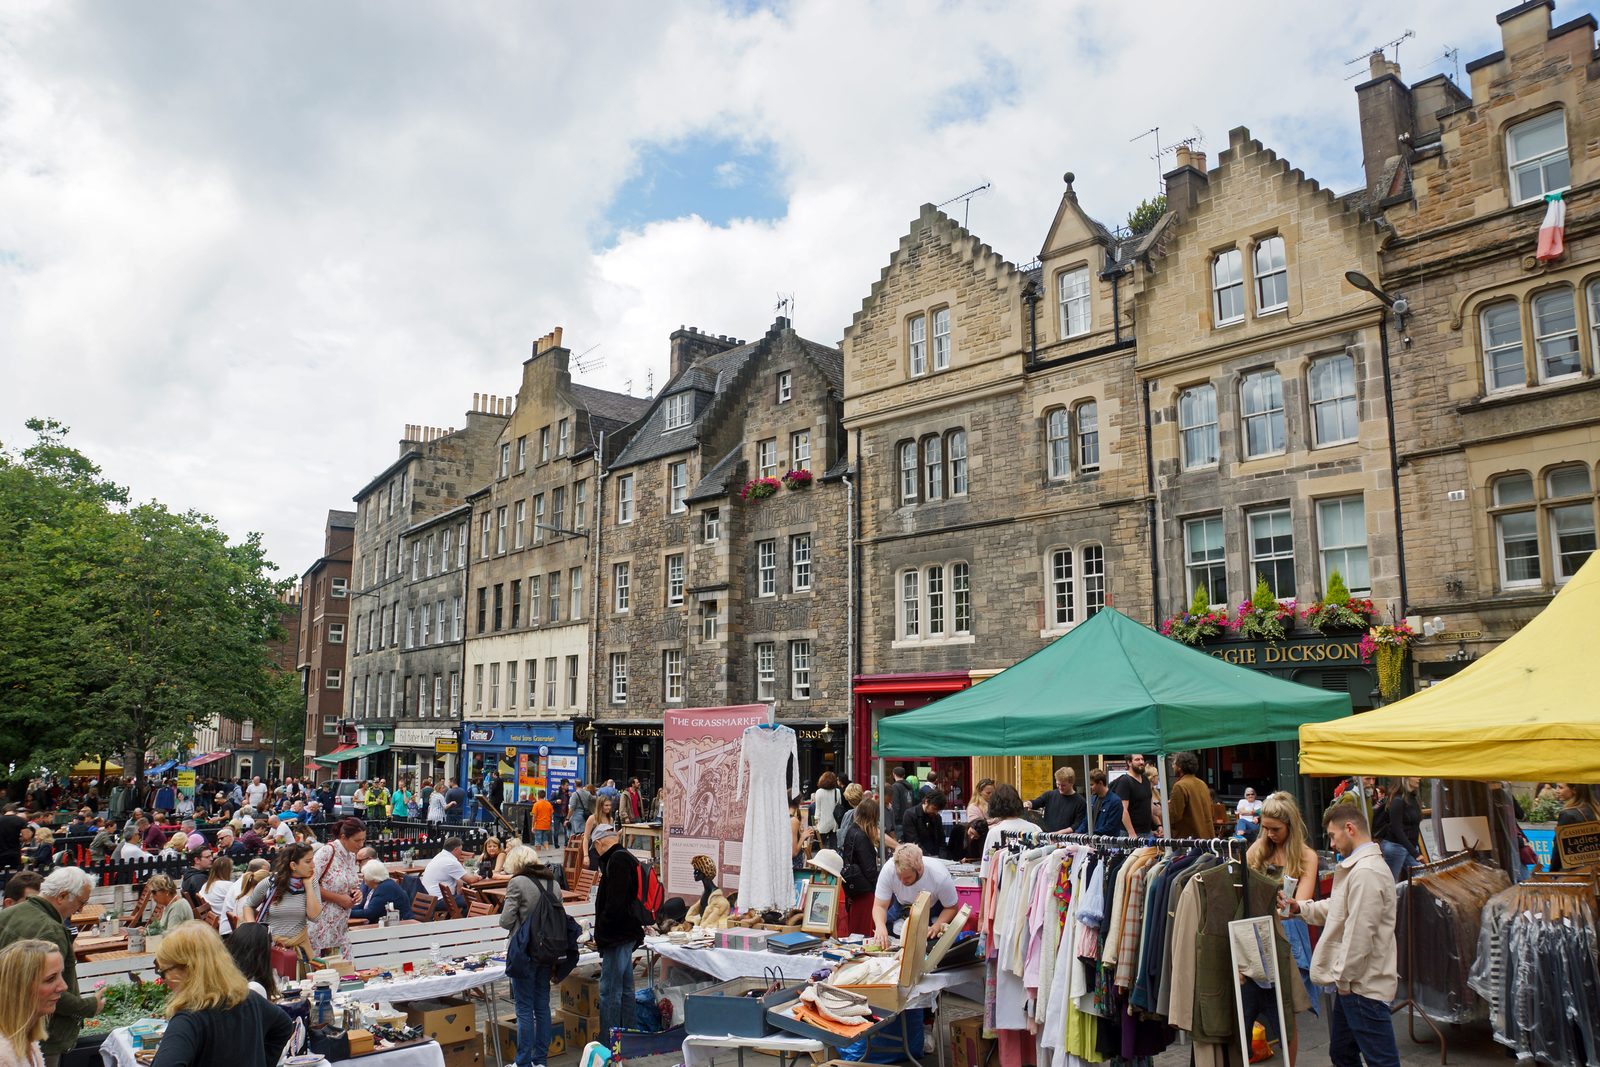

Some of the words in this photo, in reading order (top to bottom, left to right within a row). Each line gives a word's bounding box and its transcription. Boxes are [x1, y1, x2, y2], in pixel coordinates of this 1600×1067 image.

[1265, 643, 1359, 662] DICKSON
[671, 716, 689, 727] THE
[691, 716, 762, 727] GRASSMARKET
[470, 730, 488, 741] Premier
[614, 728, 627, 736] THE
[628, 728, 645, 736] LAST
[1568, 834, 1599, 846] Ladies
[1528, 840, 1549, 853] REE
[1576, 843, 1600, 854] Gent
[1569, 852, 1600, 862] CASHMER
